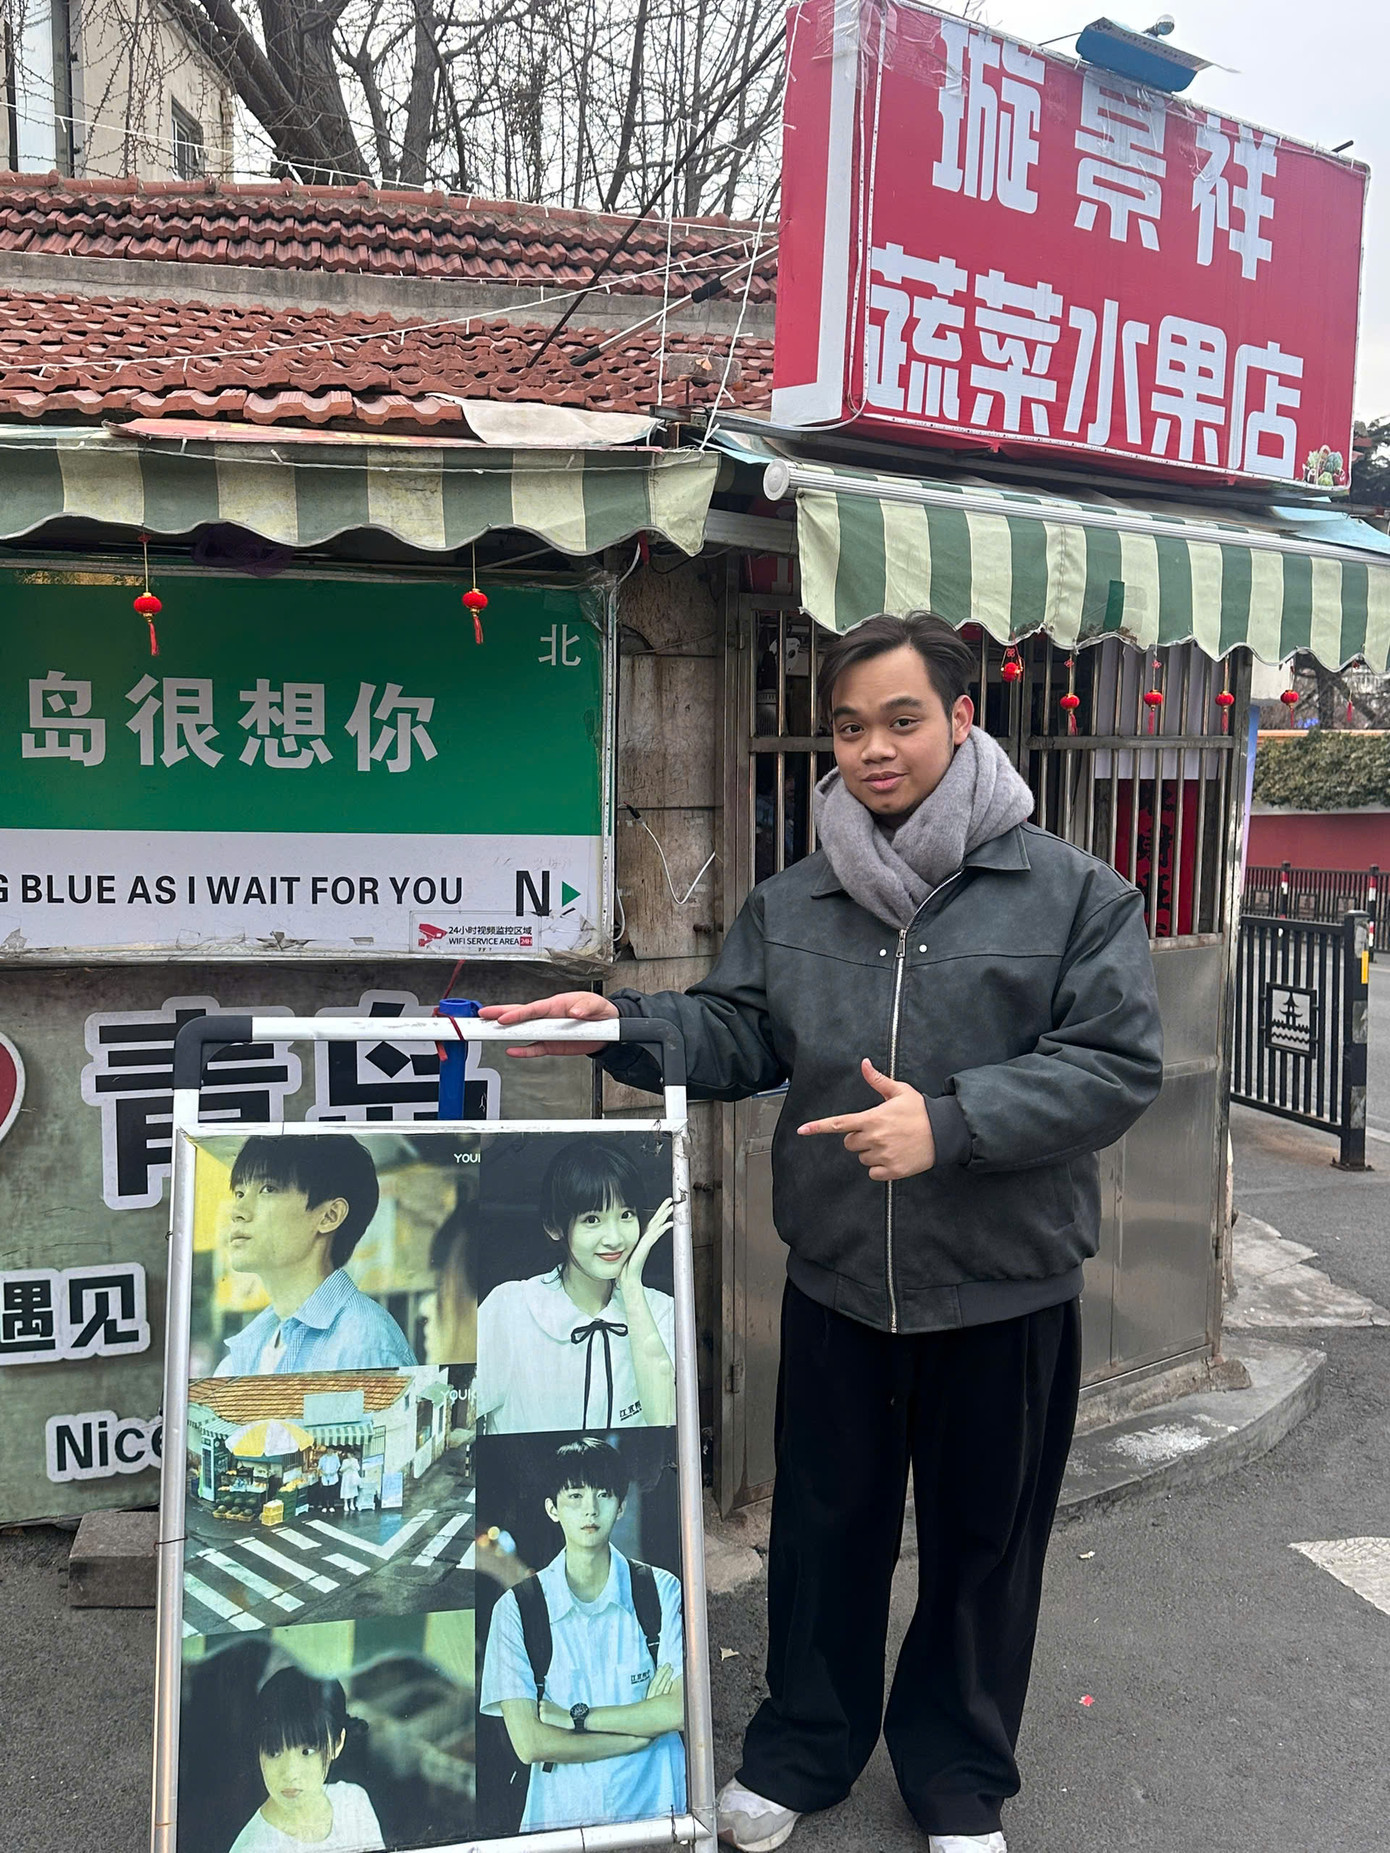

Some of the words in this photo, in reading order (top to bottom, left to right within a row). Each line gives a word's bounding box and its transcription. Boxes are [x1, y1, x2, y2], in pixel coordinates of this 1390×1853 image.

[867, 242, 1304, 479] 蔬菜水果店
[538, 624, 582, 667] 北
[21, 671, 438, 773] 岛很想你
[21, 875, 116, 904] BLUE
[127, 876, 177, 905] AS
[188, 877, 195, 905] I
[206, 877, 300, 905] WAIT
[312, 877, 379, 905] FOR
[389, 877, 464, 905] YOU
[515, 870, 550, 917] N
[448, 926, 533, 936] 24小时视频监控区域
[448, 937, 466, 945] WIFI
[466, 937, 499, 945] SERVICE
[499, 937, 520, 945] AREA
